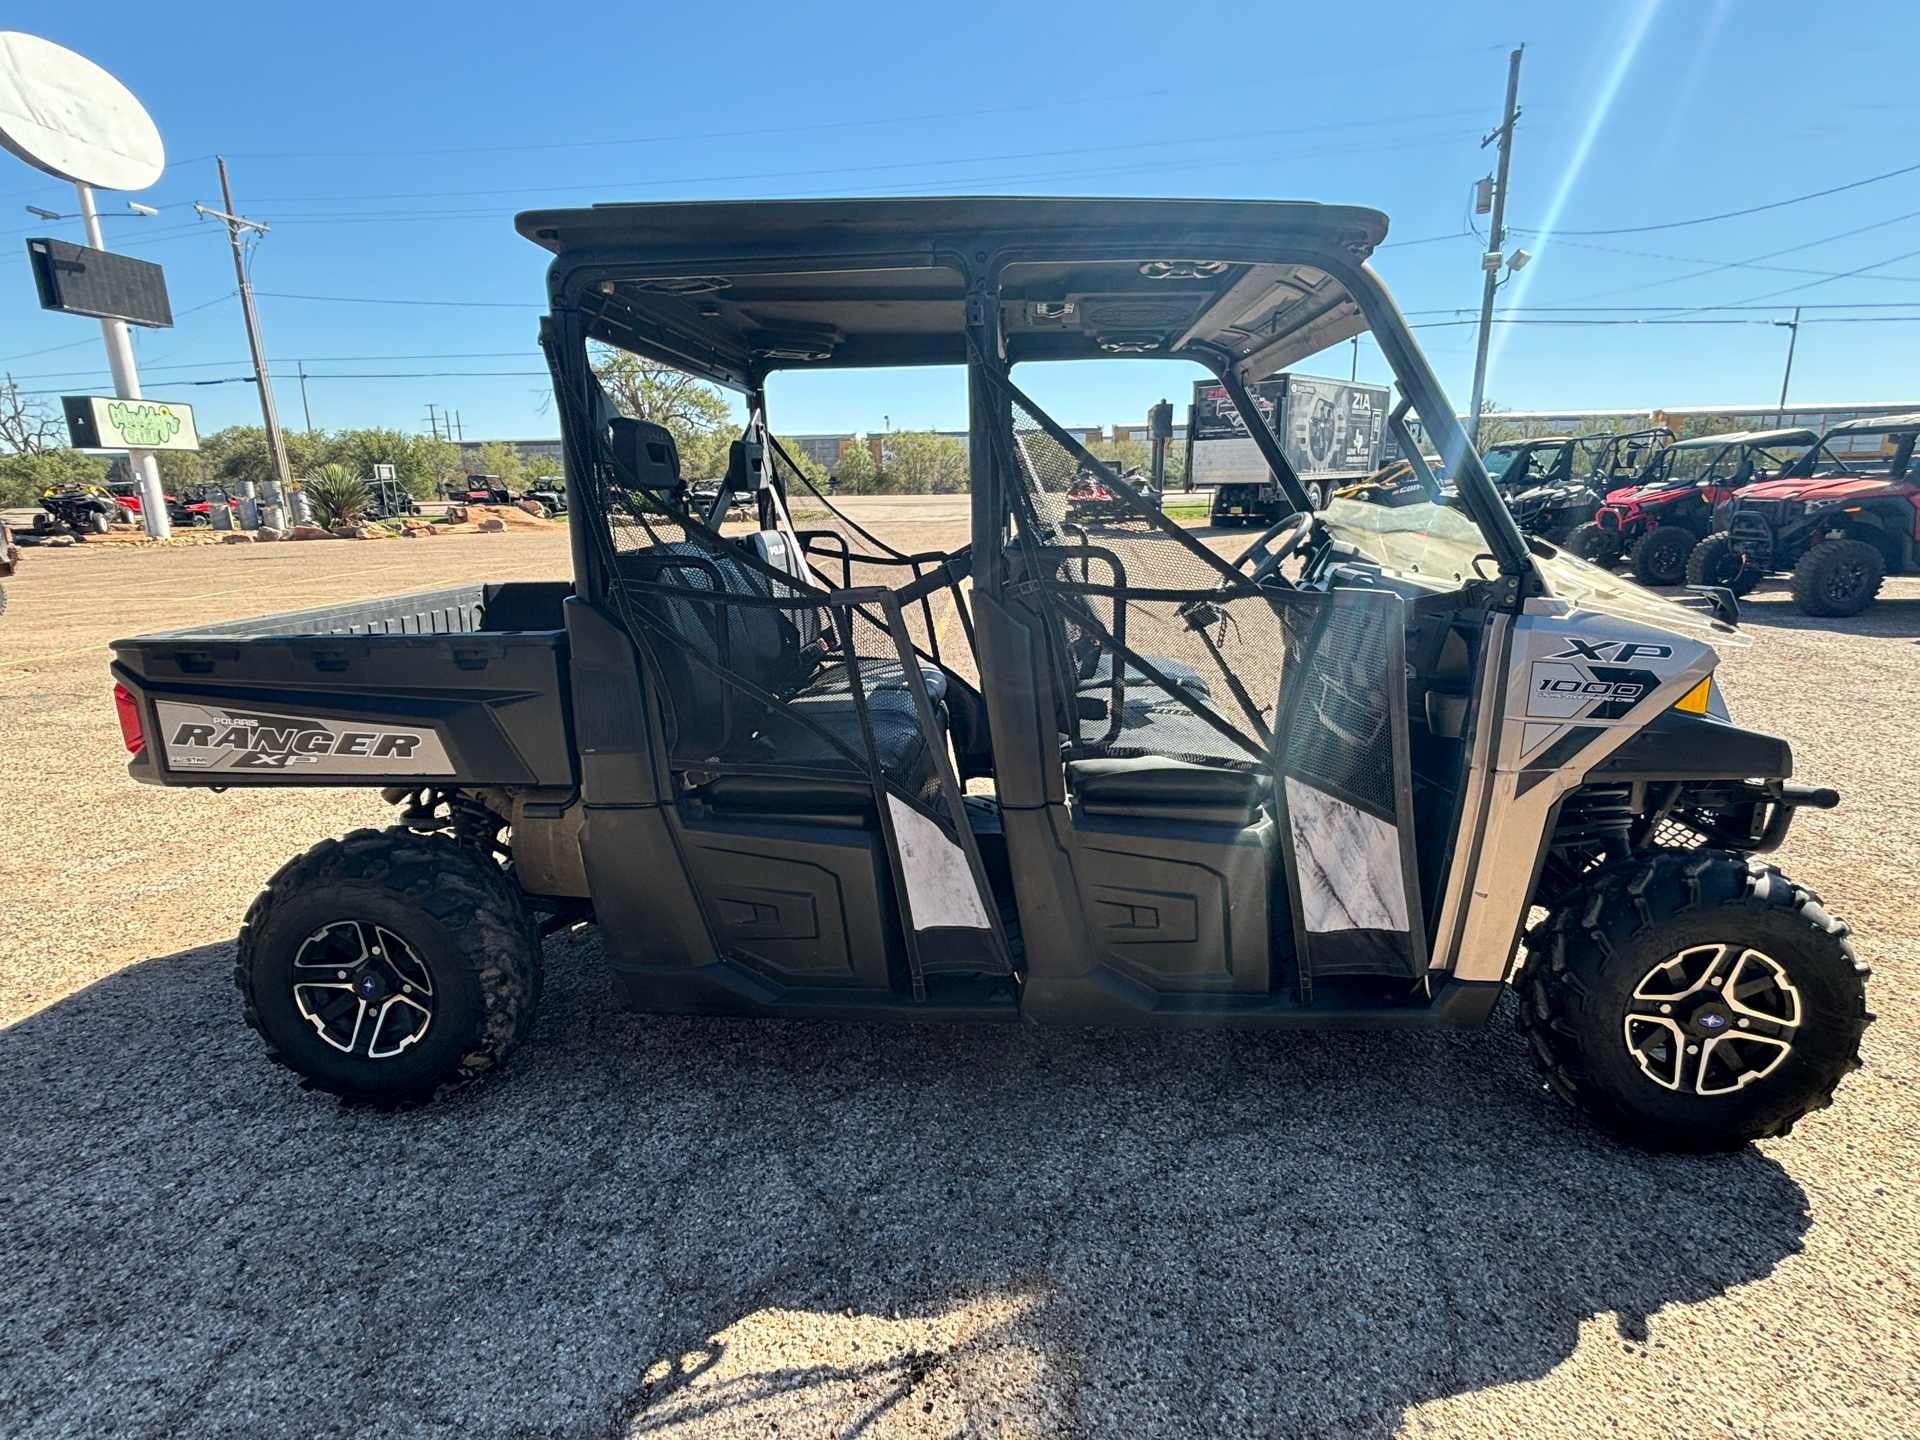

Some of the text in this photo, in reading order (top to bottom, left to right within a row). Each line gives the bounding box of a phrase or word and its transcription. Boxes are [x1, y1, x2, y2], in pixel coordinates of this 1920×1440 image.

[1352, 392, 1371, 410] ZIA
[1542, 637, 1675, 665] XP
[1536, 678, 1644, 698] 1000
[1565, 694, 1614, 702] OVERHEAD
[213, 717, 259, 727] POLARIS
[169, 722, 422, 760] RANGER
[249, 752, 320, 767] XP
